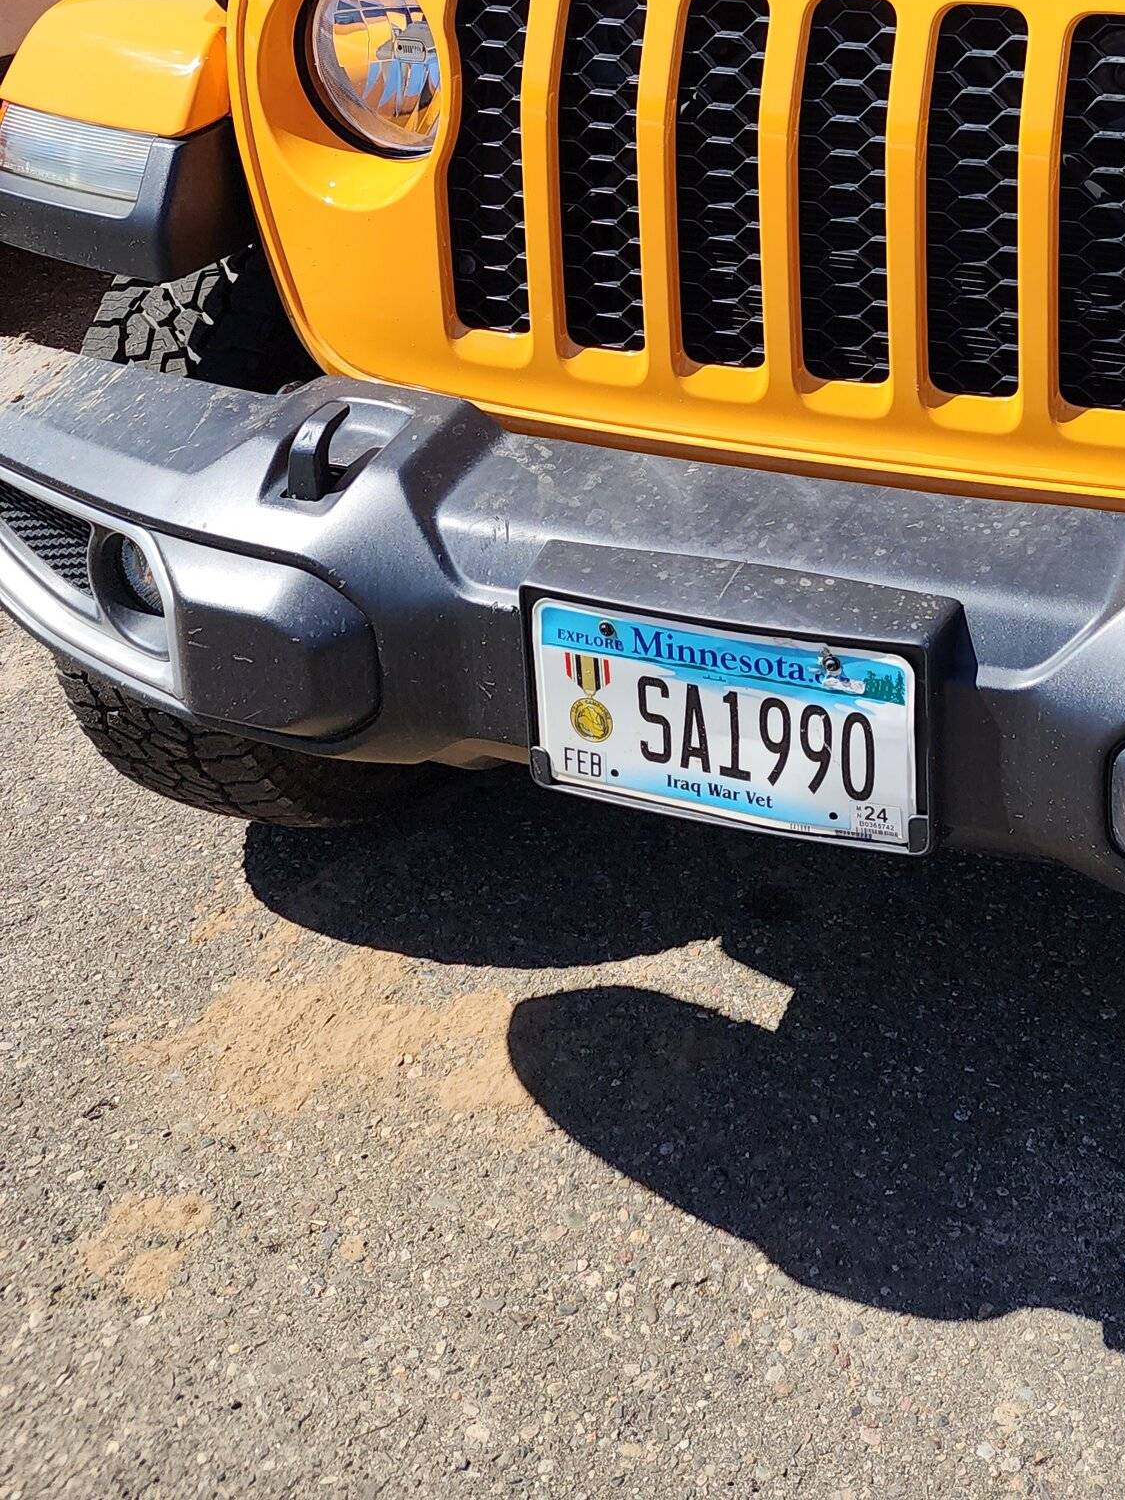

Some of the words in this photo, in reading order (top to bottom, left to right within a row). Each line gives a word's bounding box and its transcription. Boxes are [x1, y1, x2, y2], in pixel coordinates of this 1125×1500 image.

[557, 628, 624, 651] EXPLORE
[638, 675, 875, 801] SA1990
[564, 747, 601, 777] FEB
[666, 774, 701, 797] Iraq
[708, 782, 740, 802] War
[745, 790, 774, 809] Vet
[864, 806, 888, 823] 24
